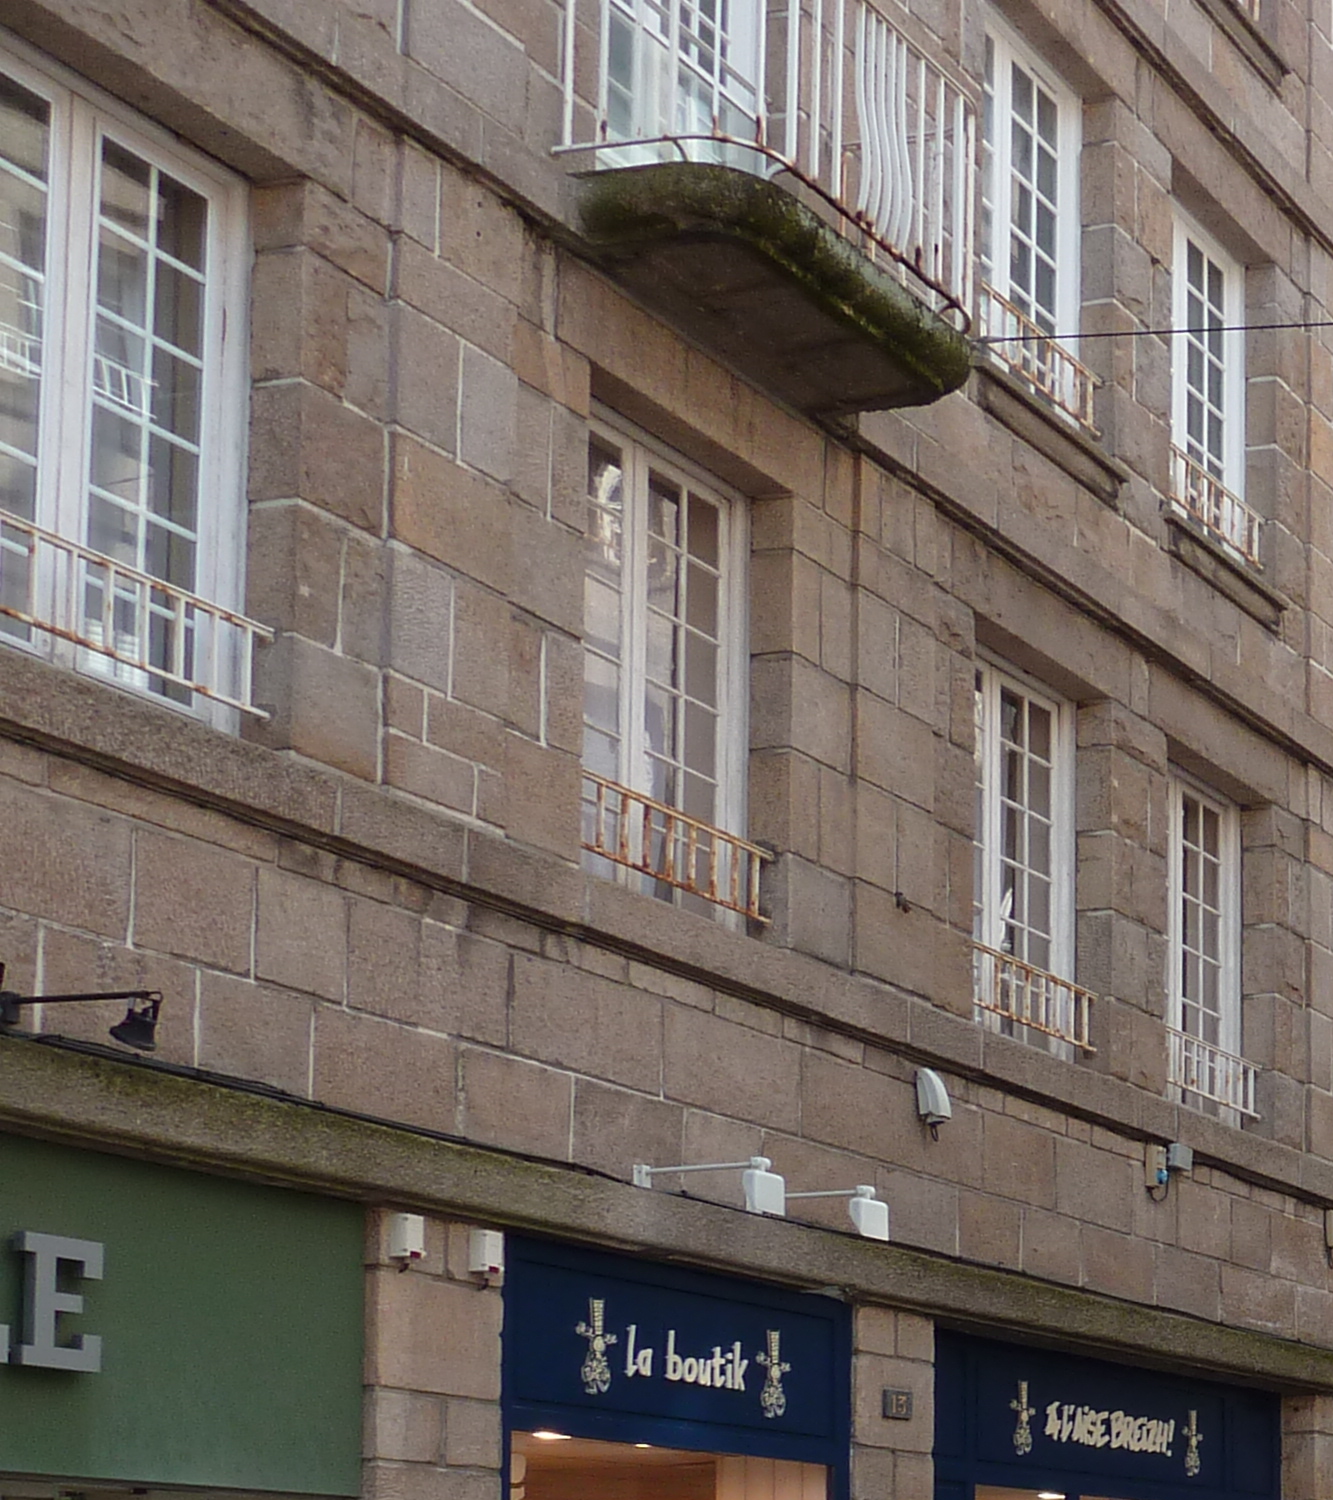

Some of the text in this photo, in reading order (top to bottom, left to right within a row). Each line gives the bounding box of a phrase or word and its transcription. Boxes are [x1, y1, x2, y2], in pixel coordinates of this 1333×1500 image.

[0, 1231, 103, 1372] E
[624, 1324, 749, 1392] la boutik
[892, 1395, 907, 1415] 13
